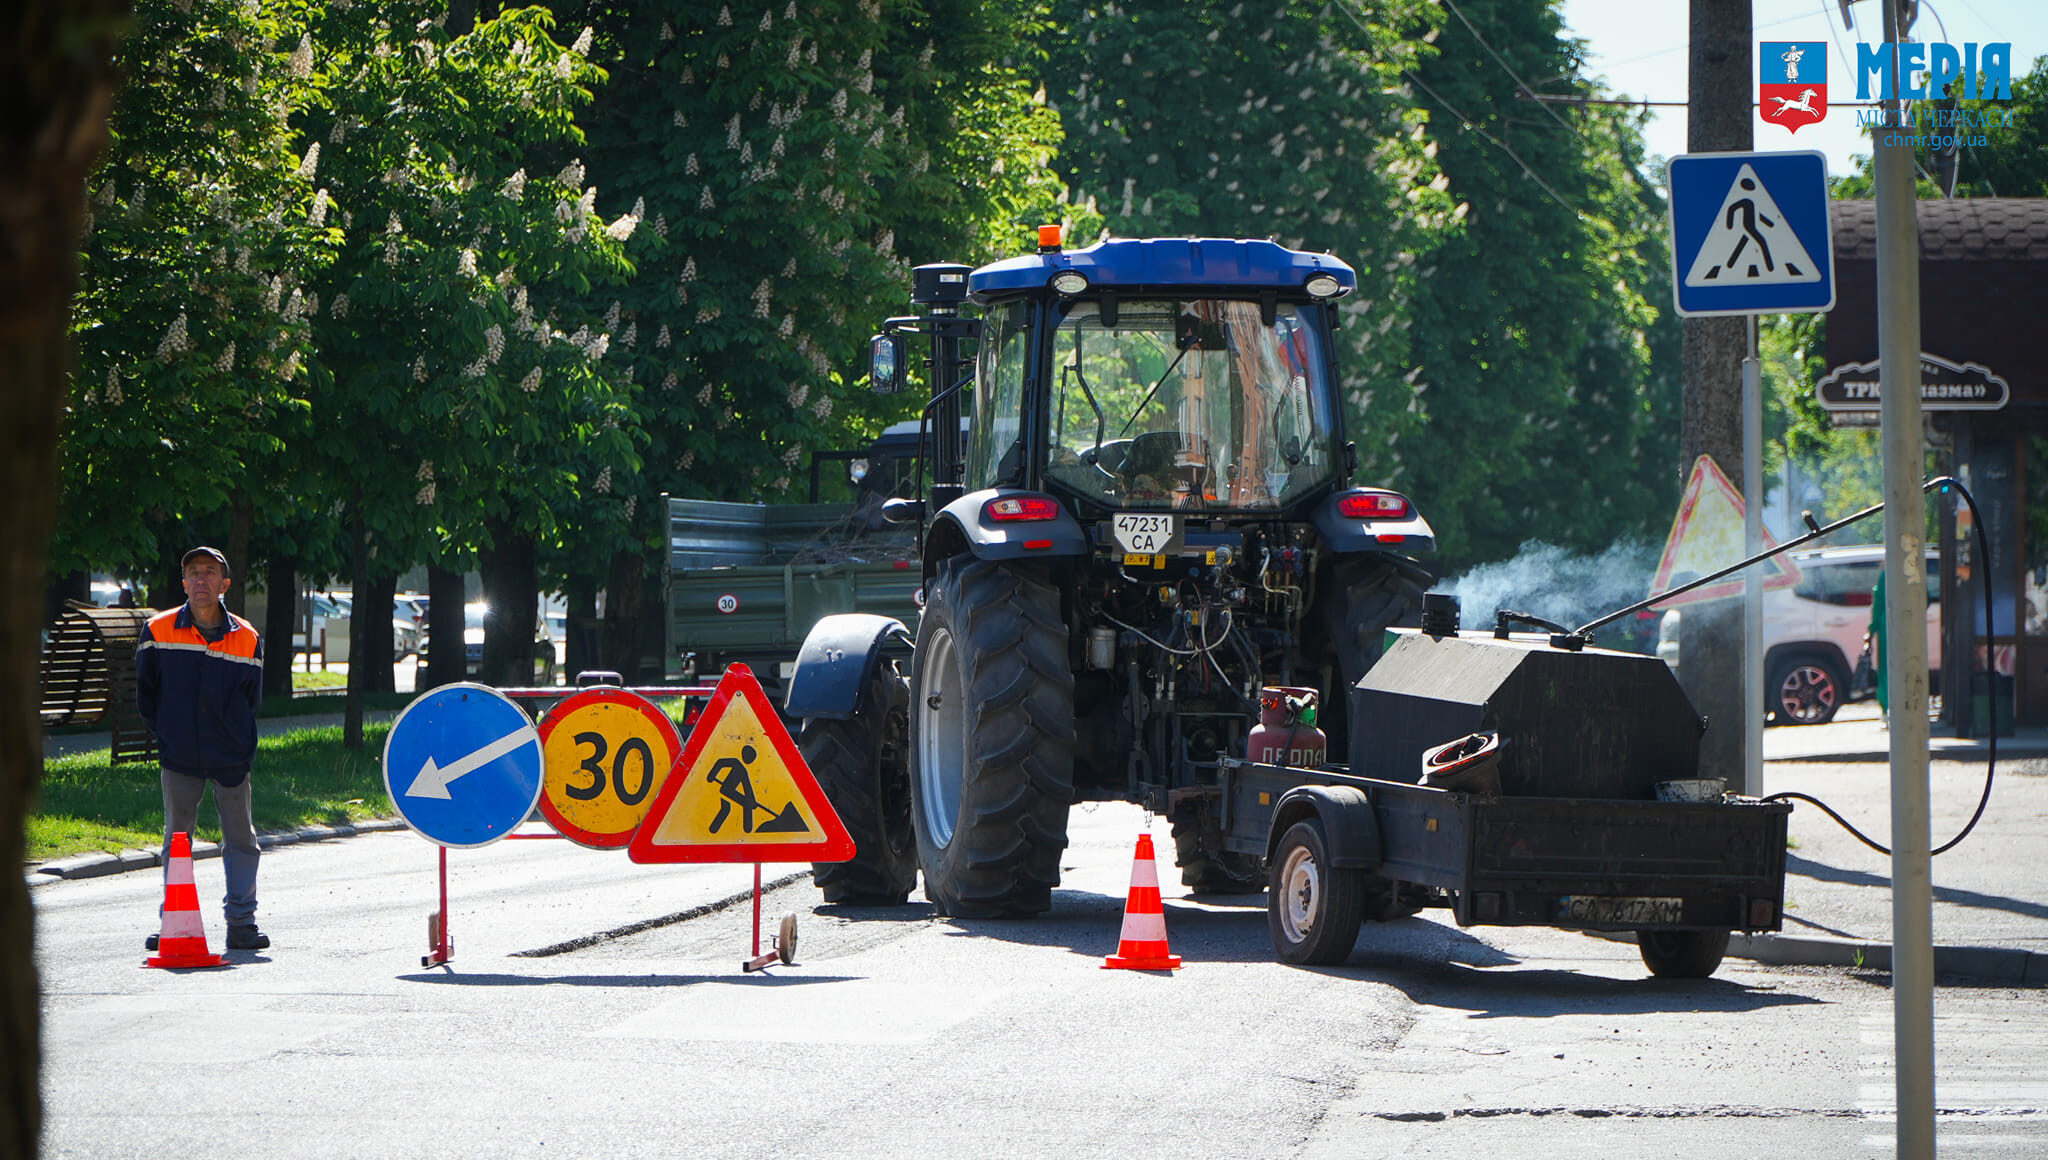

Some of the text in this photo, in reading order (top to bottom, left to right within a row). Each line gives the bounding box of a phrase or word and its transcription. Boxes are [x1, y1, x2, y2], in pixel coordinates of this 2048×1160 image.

[1118, 516, 1169, 533] 47231
[721, 598, 734, 610] 30
[564, 731, 655, 807] 30
